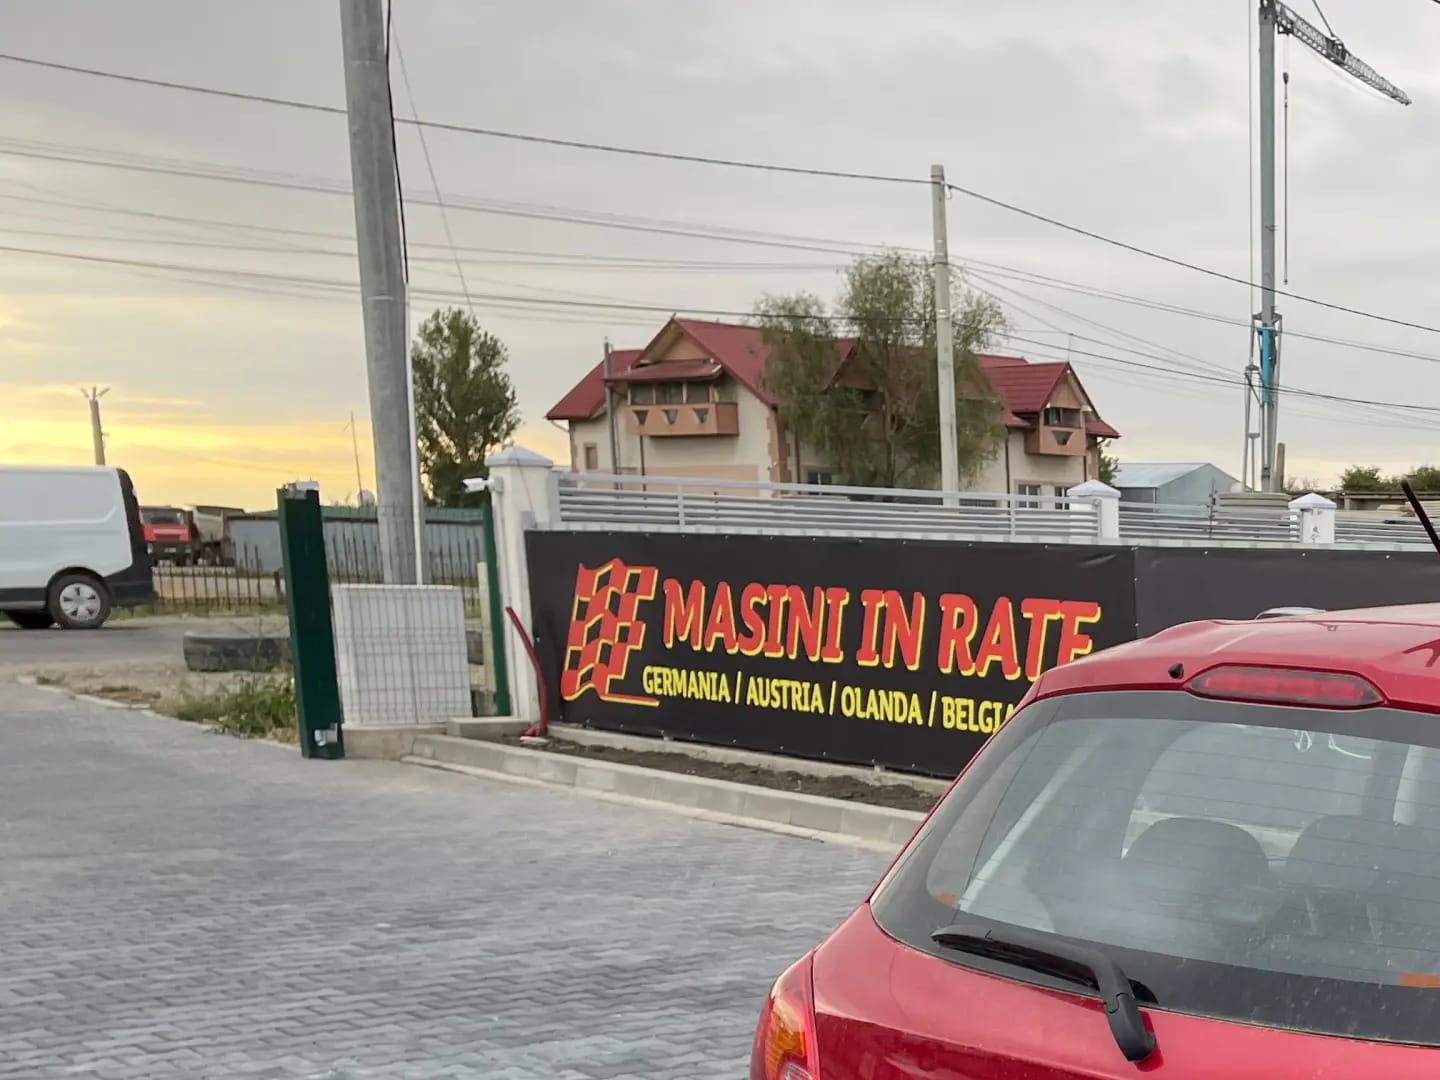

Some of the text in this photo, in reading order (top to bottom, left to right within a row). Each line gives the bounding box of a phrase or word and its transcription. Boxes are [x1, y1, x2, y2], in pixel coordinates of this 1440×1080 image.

[663, 578, 1101, 682] MASINI IN RATE
[642, 666, 731, 704] GERMANIA
[746, 678, 824, 714] AUSTRIA
[841, 690, 924, 726] OLANDA
